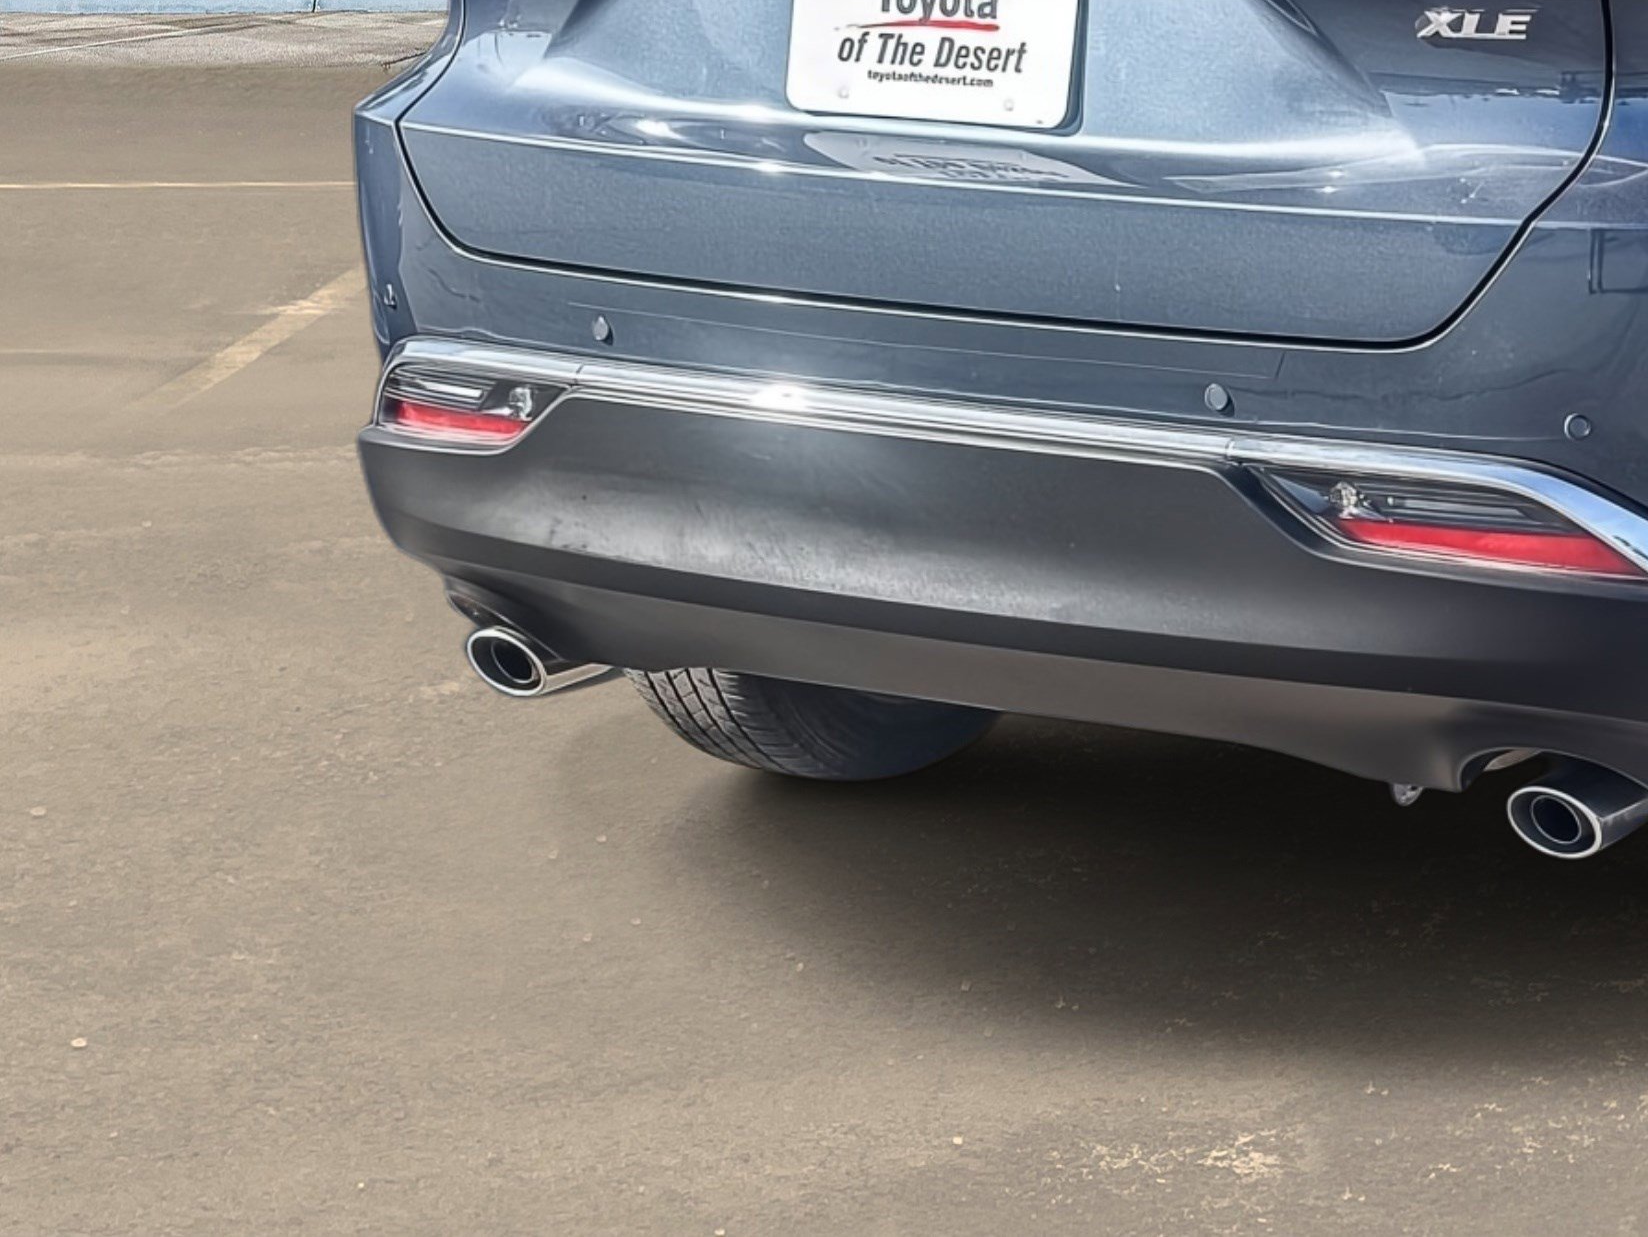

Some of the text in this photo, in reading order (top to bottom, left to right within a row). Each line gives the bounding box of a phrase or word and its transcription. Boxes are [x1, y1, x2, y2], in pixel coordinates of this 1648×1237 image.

[1416, 10, 1532, 40] XLE
[837, 31, 1028, 74] of The Desert
[867, 69, 994, 88] toyotaofthedesert.com
